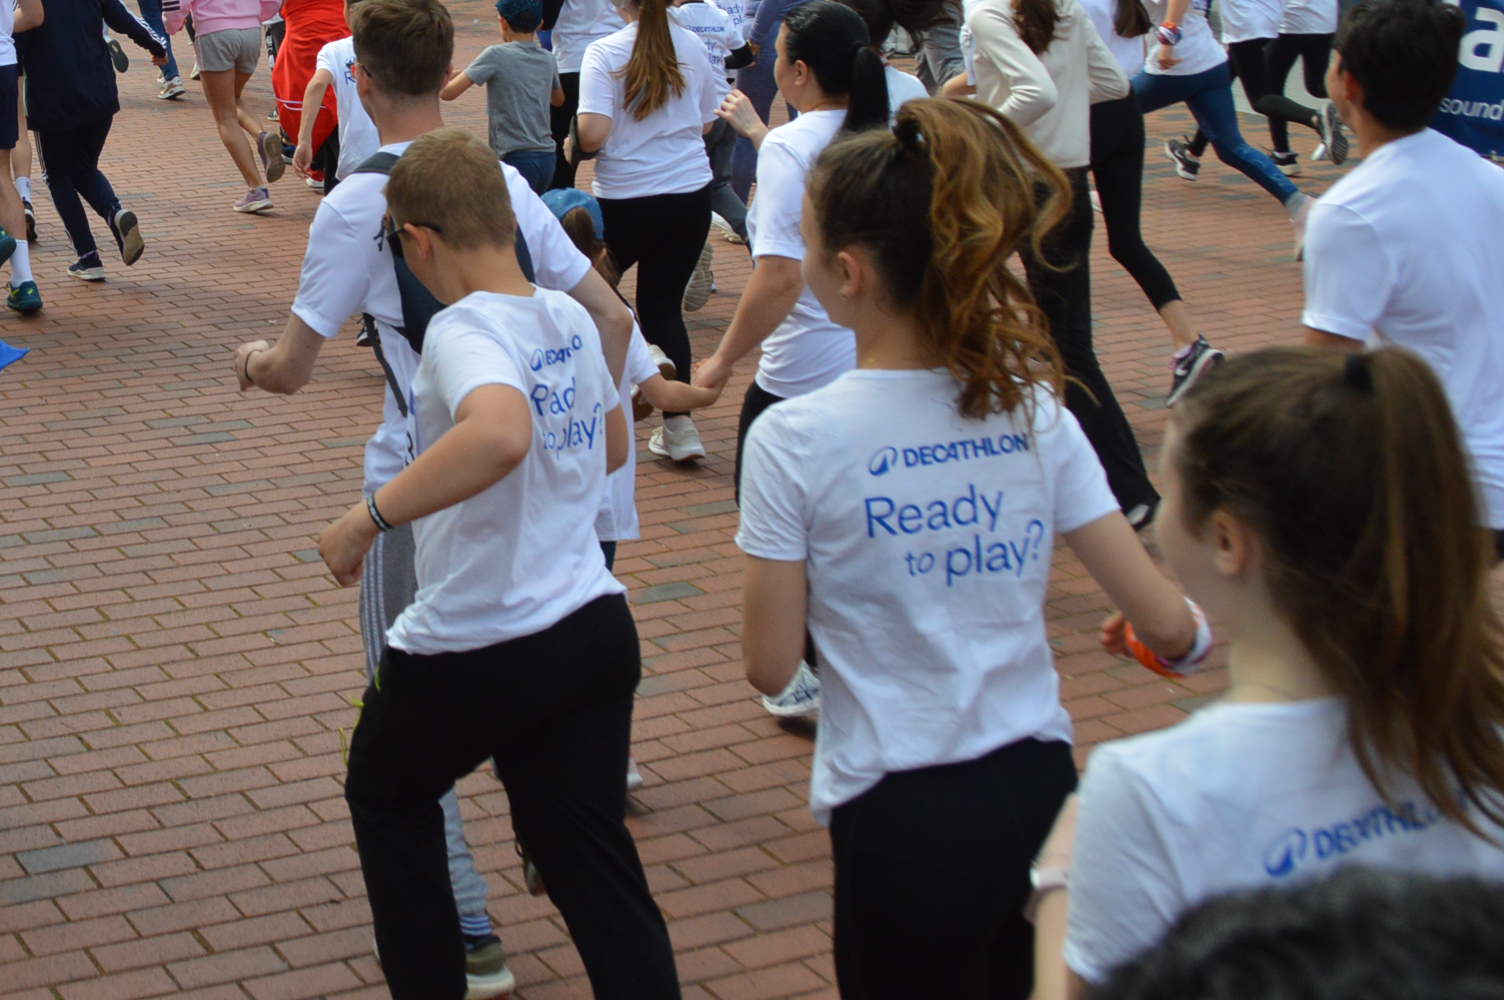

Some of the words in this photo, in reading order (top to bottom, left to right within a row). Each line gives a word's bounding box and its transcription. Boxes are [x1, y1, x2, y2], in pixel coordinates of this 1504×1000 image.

[902, 432, 1030, 468] DECATHLON
[864, 483, 1004, 538] Ready
[904, 551, 936, 577] to
[946, 519, 1045, 588] play?
